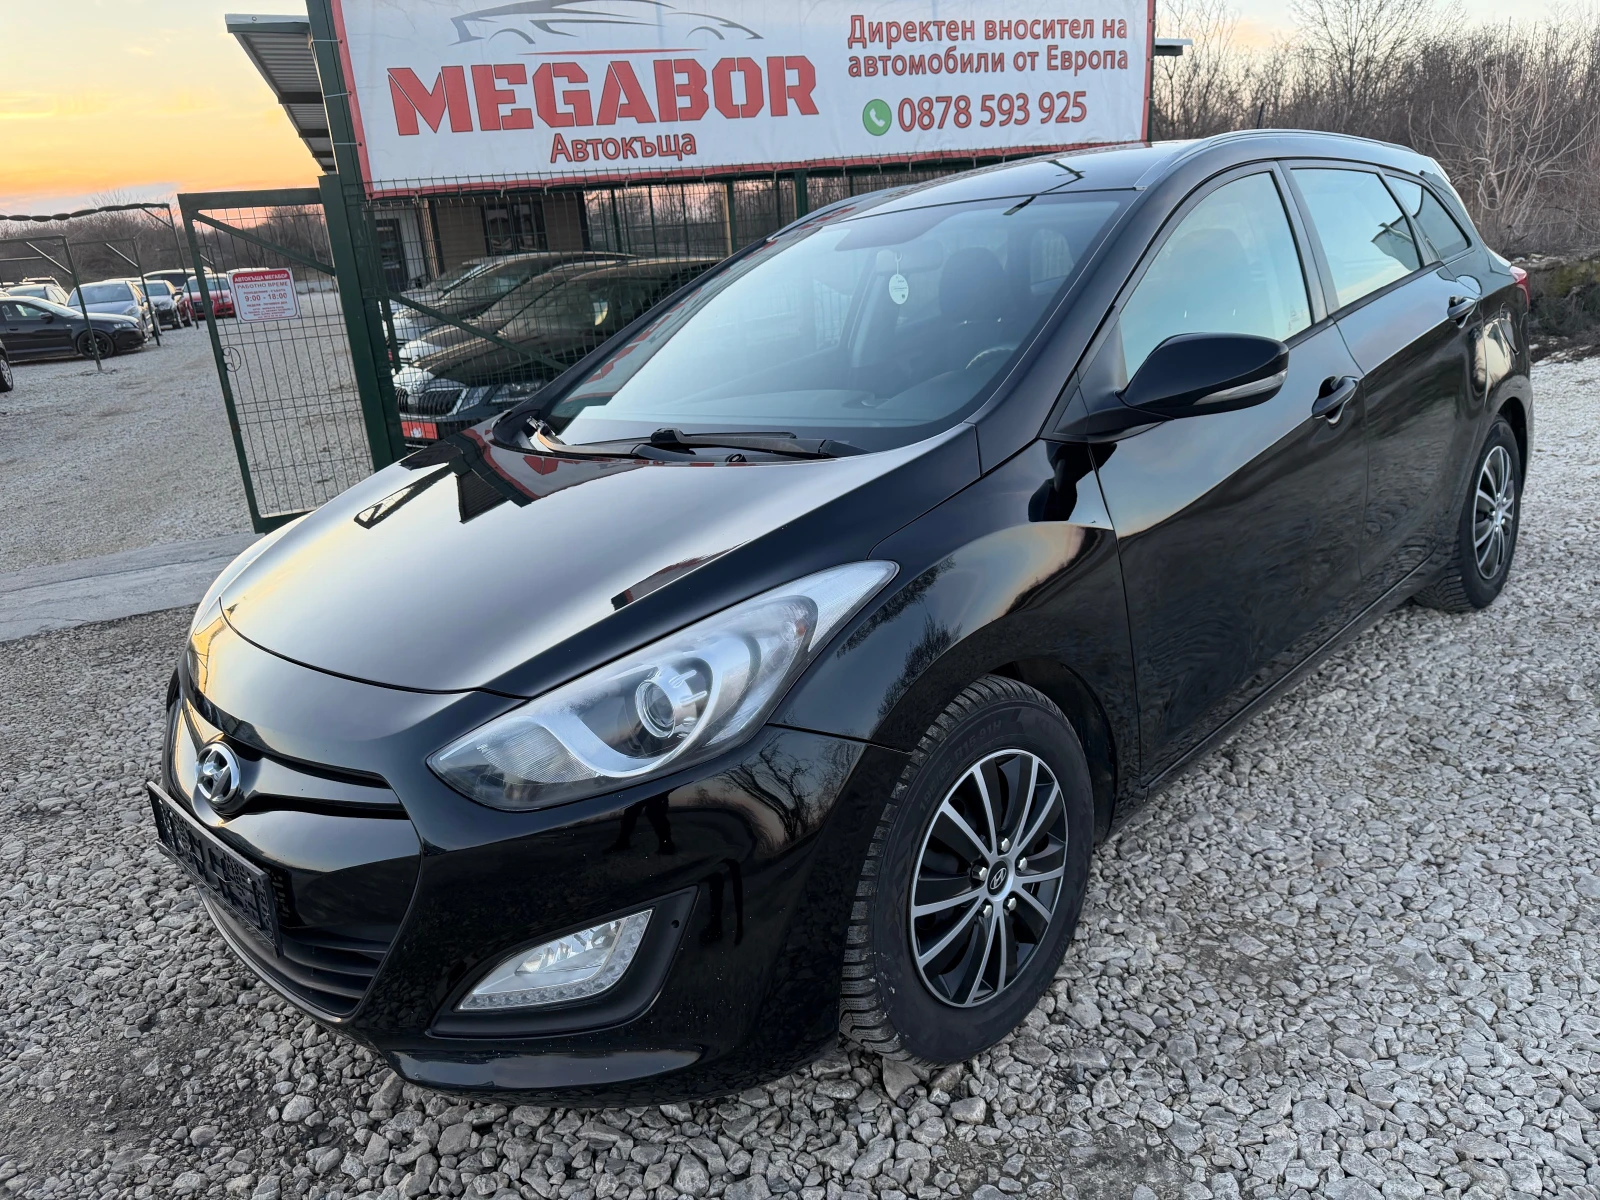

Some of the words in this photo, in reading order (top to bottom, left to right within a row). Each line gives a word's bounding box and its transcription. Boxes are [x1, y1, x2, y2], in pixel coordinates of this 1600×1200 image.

[847, 14, 975, 50] Директен
[984, 19, 1094, 41] вносител
[1101, 18, 1128, 39] на
[848, 46, 1005, 78] автомобили
[1013, 49, 1039, 72] от
[1046, 45, 1128, 76] Европа
[387, 55, 819, 136] MEGABOR
[897, 95, 972, 132] 0878
[979, 92, 1030, 127] 593
[1038, 91, 1087, 124] 925
[550, 131, 697, 163] Автокъща
